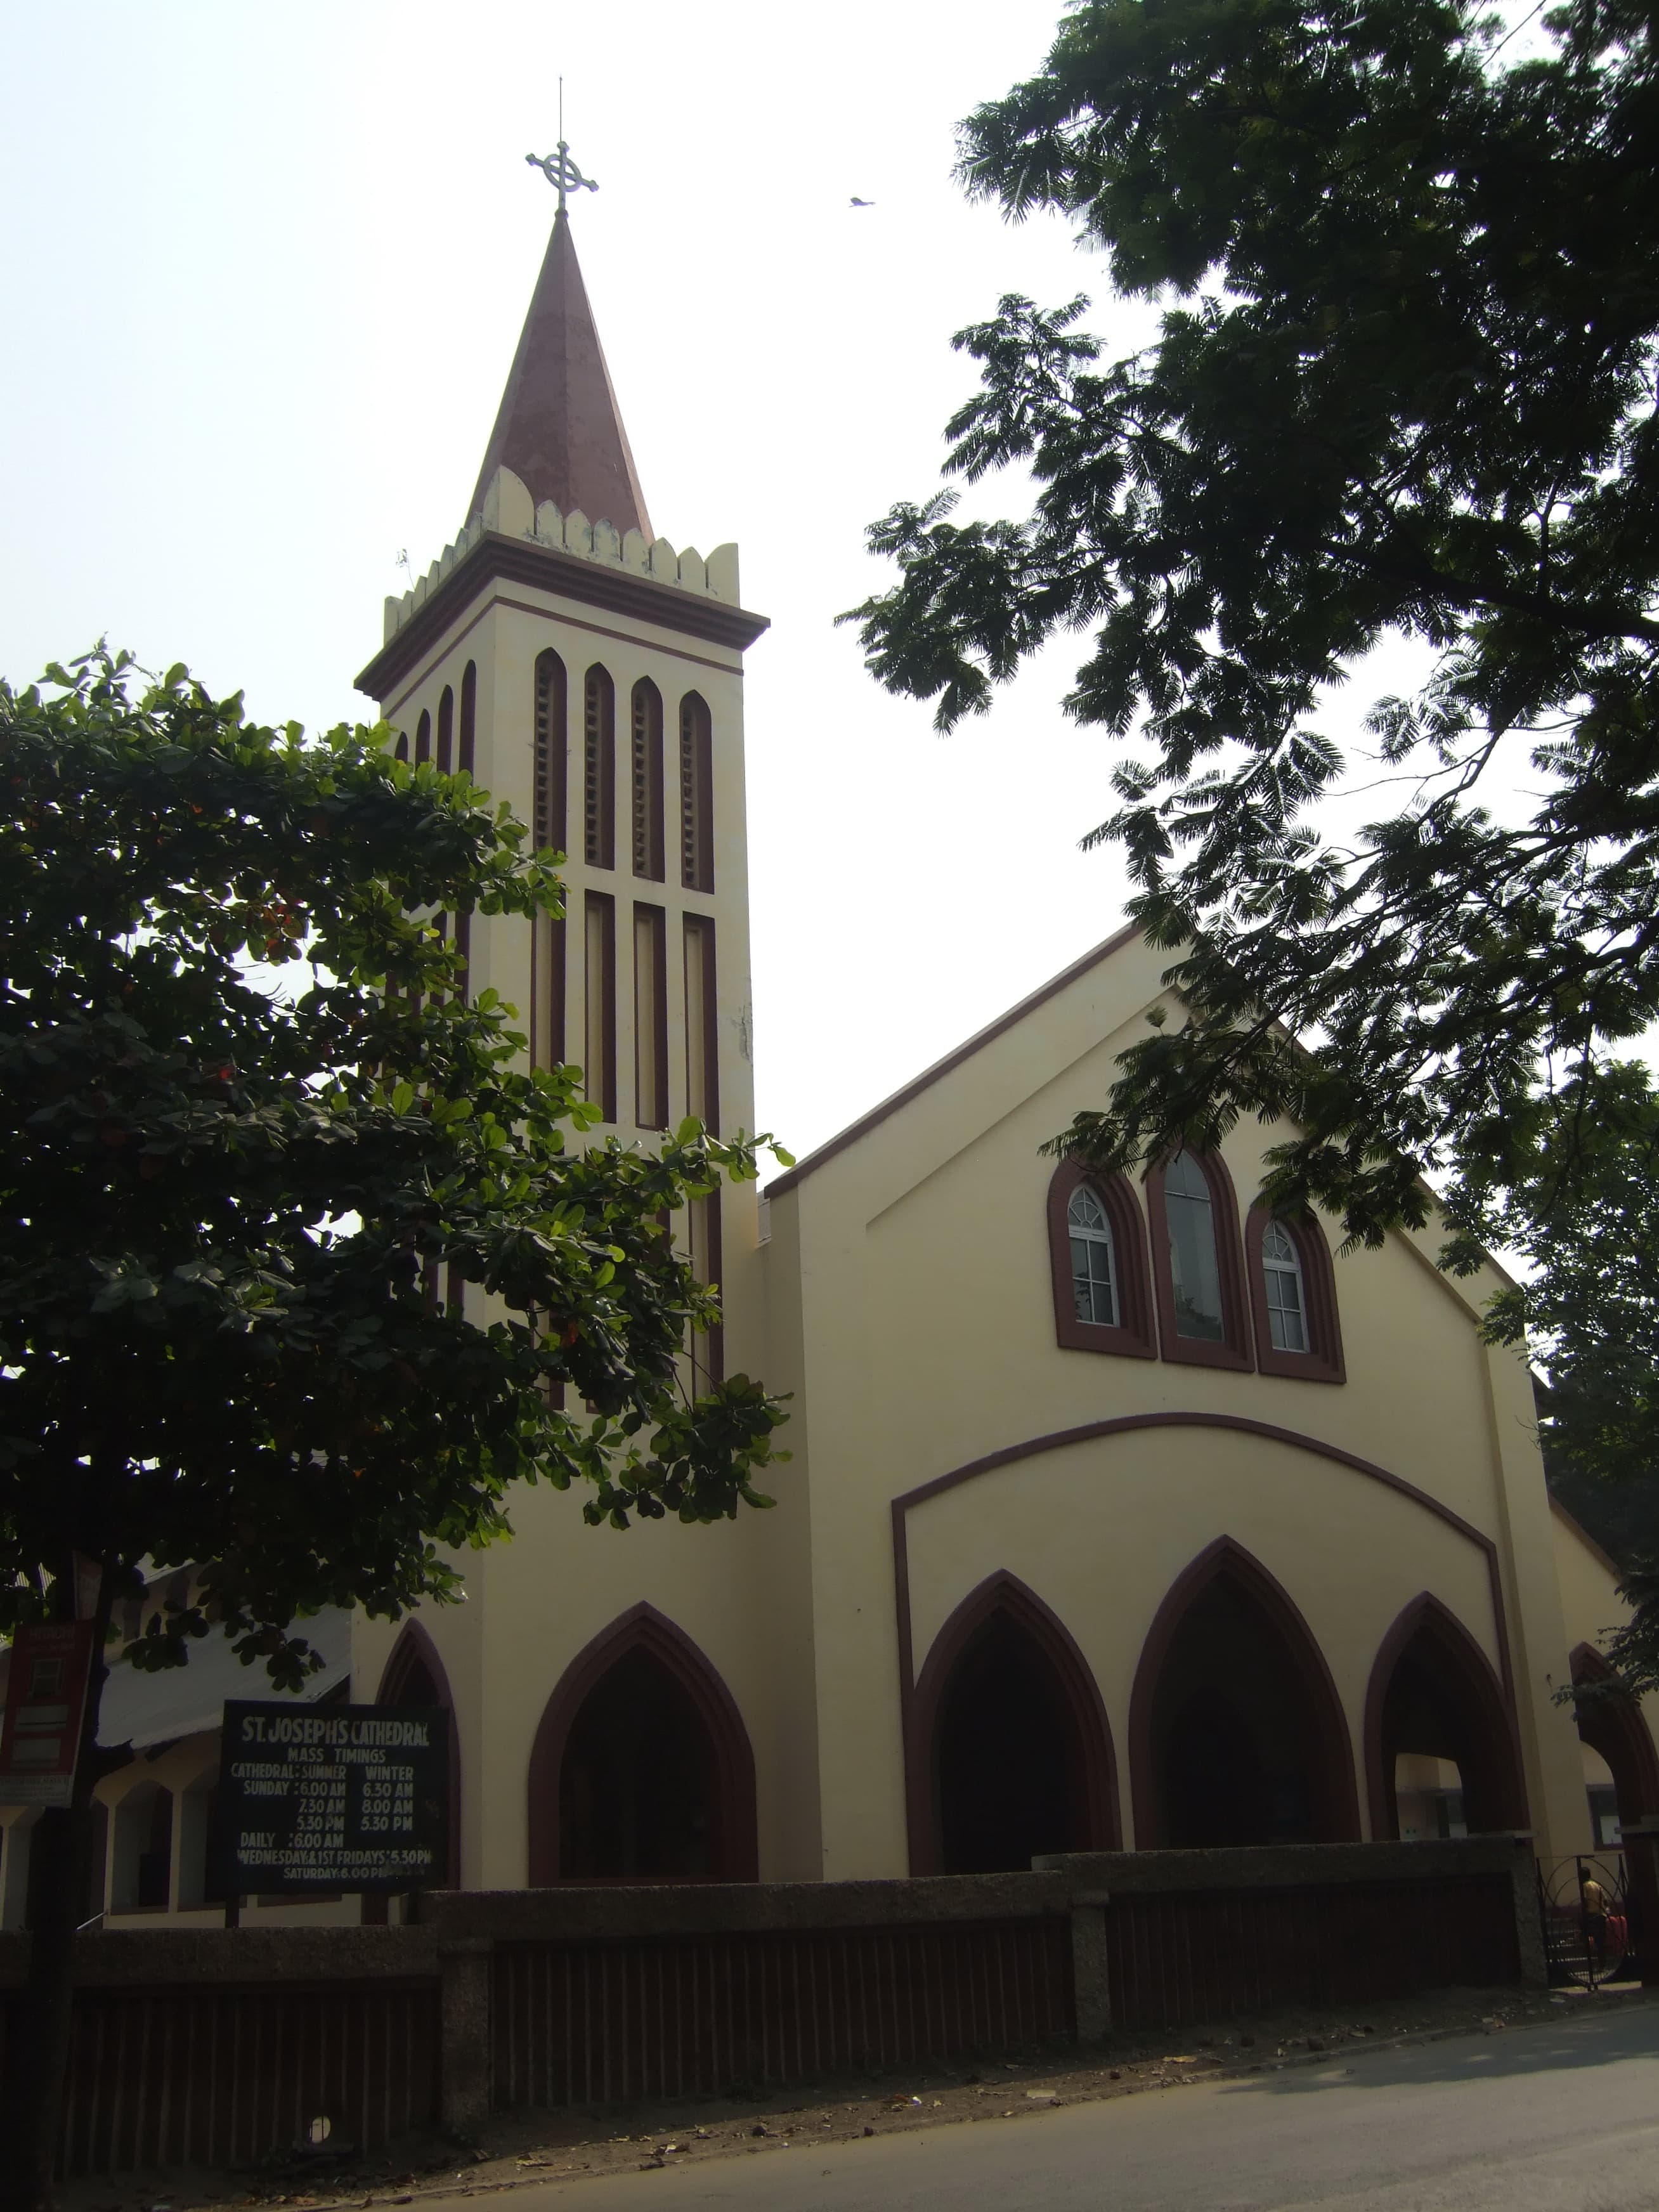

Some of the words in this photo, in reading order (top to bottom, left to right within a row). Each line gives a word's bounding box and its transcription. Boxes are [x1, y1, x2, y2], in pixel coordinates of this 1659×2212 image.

[268, 1717, 348, 1745] JOSEPH'S
[351, 1720, 429, 1746] CATHEDRAL
[288, 1747, 324, 1762] MASS
[334, 1748, 386, 1763] TIMINGS
[302, 1765, 346, 1779] SUMMER
[365, 1766, 413, 1781] WINTER
[244, 1781, 289, 1796] SUNDAY
[330, 1783, 346, 1797] AM
[363, 1783, 392, 1797] 6.30
[394, 1783, 413, 1797] AM
[299, 1799, 325, 1813] 7.30
[327, 1800, 346, 1813] AM
[361, 1800, 391, 1814] 8.00
[393, 1800, 413, 1814] AM
[297, 1816, 323, 1831] 5.30
[325, 1816, 345, 1831] PM
[360, 1816, 389, 1831] 5.30
[393, 1817, 413, 1831] PM
[240, 1832, 275, 1847] DAILY
[324, 1833, 344, 1847] AM
